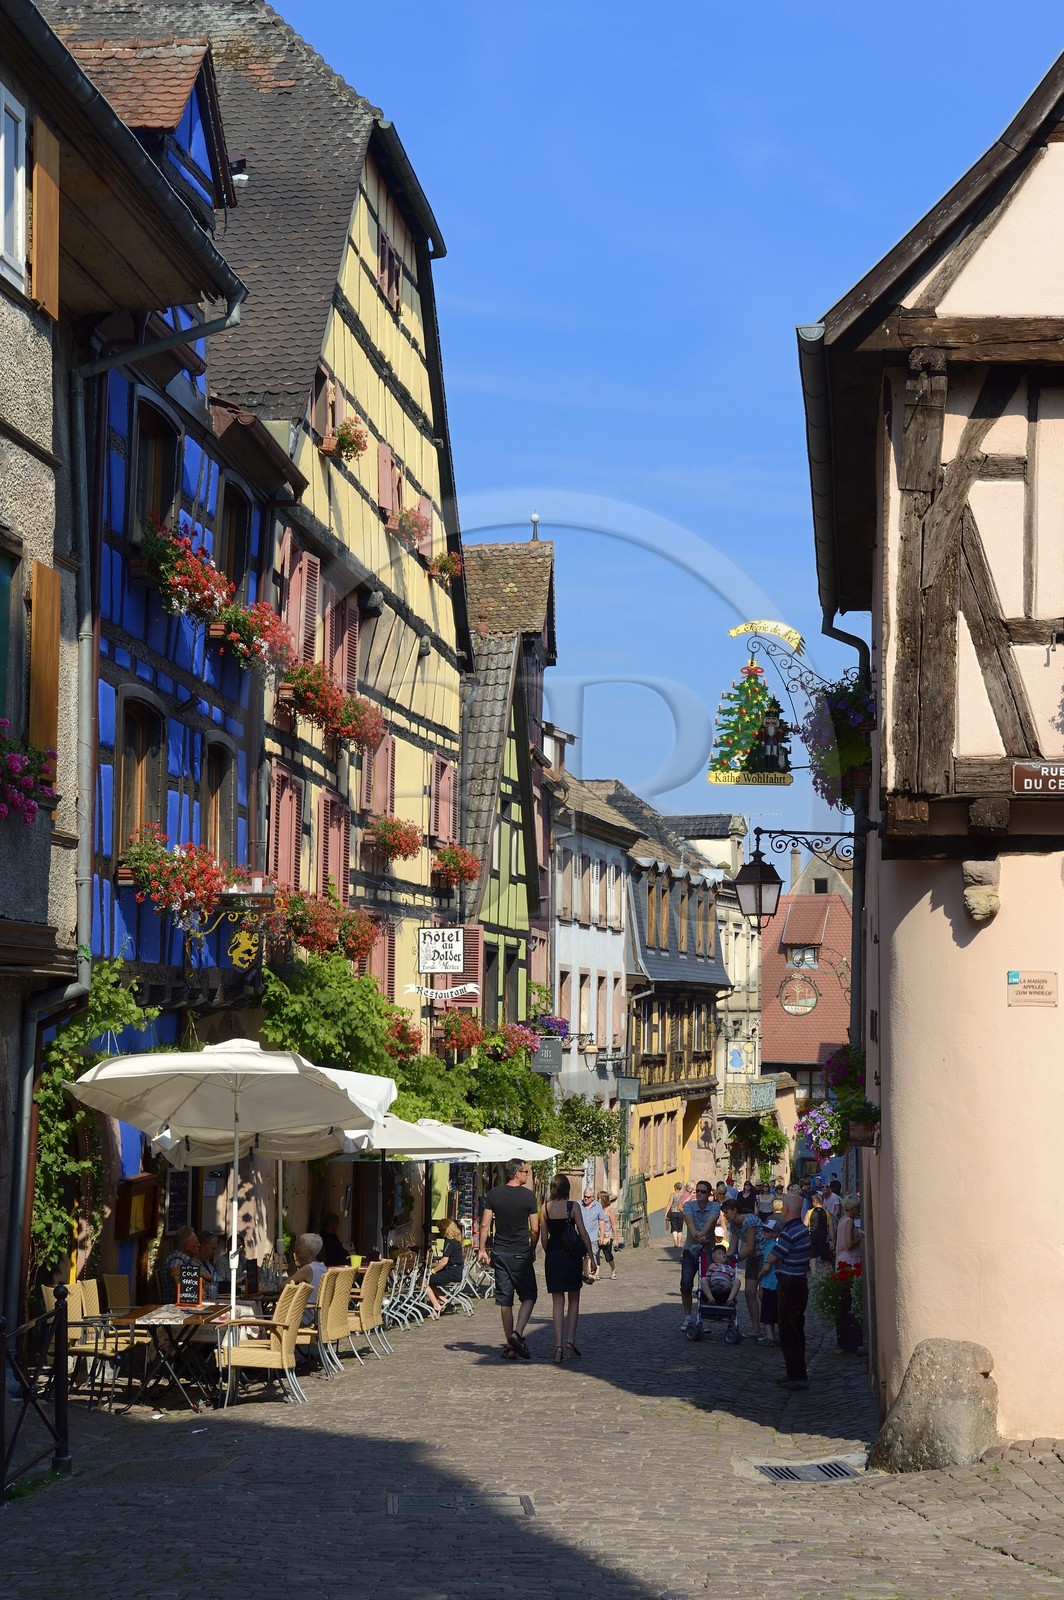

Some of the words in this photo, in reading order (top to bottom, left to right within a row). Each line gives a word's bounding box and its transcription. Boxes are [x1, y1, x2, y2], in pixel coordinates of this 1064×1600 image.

[1041, 766, 1064, 776] RUE
[715, 772, 741, 783] Käthe
[743, 773, 786, 784] Wohlfahrt
[1024, 778, 1043, 790] DU
[422, 930, 460, 944] Hôtel
[431, 949, 461, 961] Dolder
[416, 986, 467, 998] Restaurant
